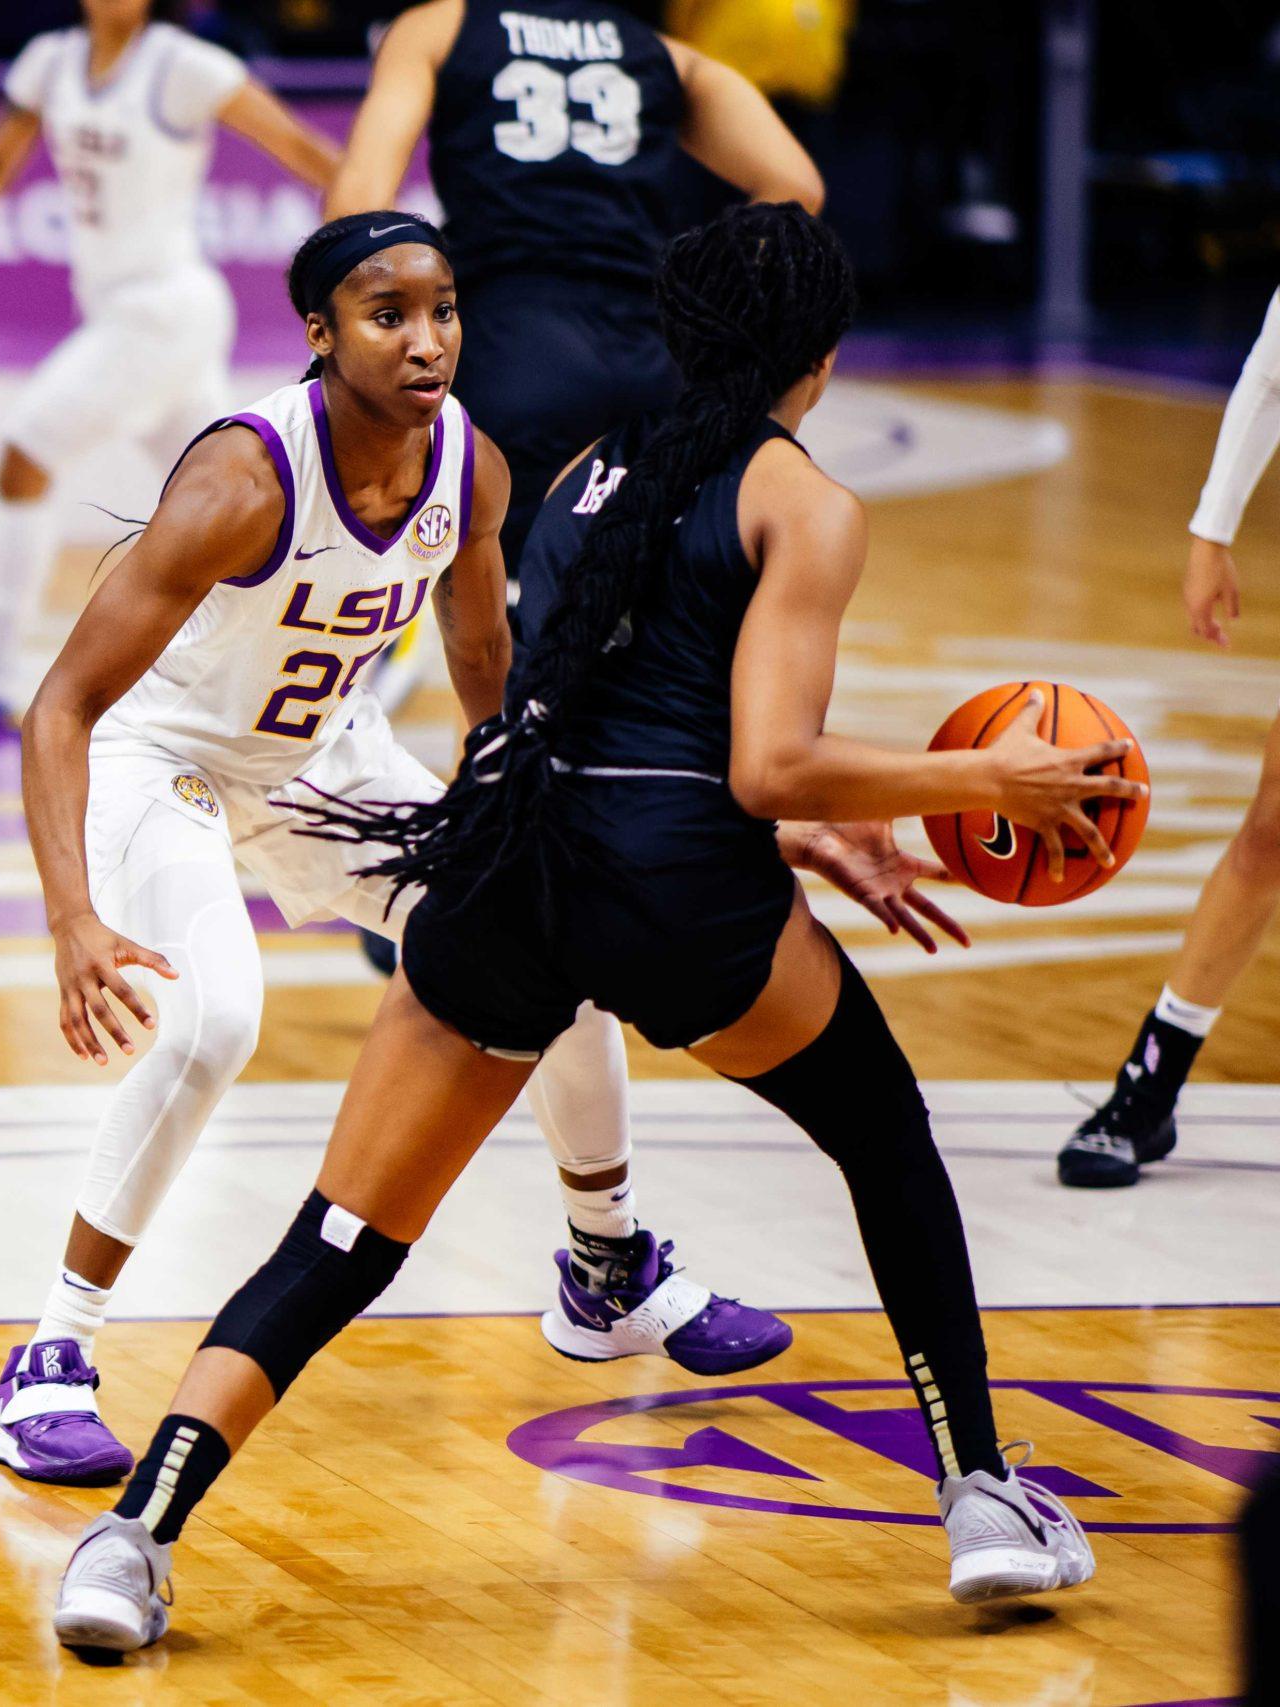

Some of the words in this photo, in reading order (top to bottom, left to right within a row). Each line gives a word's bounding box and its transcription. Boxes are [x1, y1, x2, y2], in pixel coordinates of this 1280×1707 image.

[499, 11, 624, 61] THOMAS
[492, 59, 641, 166] 33
[418, 507, 451, 545] SEC
[277, 576, 430, 637] LSU
